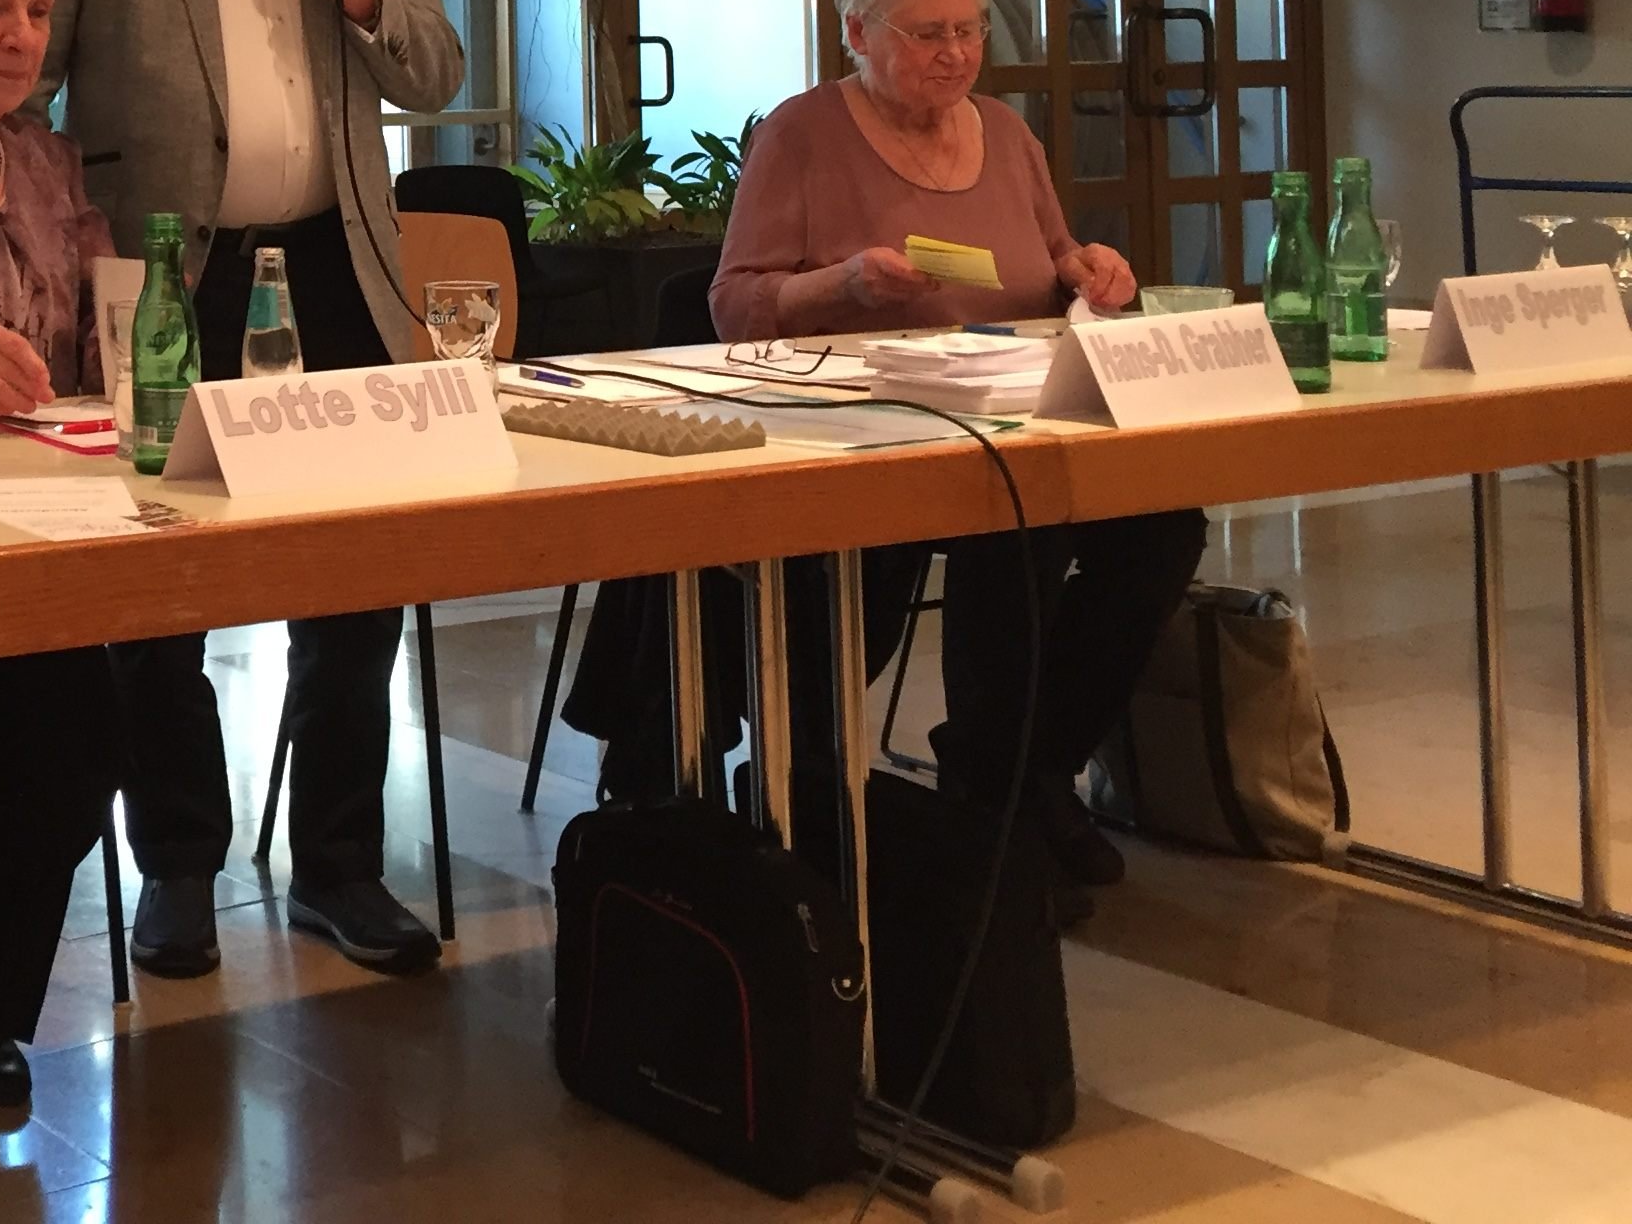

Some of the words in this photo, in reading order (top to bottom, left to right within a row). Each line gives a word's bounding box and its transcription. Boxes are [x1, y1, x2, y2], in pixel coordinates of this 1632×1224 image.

[1456, 288, 1516, 335] Inge
[1087, 326, 1189, 385] Hans-D.
[210, 380, 357, 438] Lotte
[364, 365, 478, 432] Sylli
